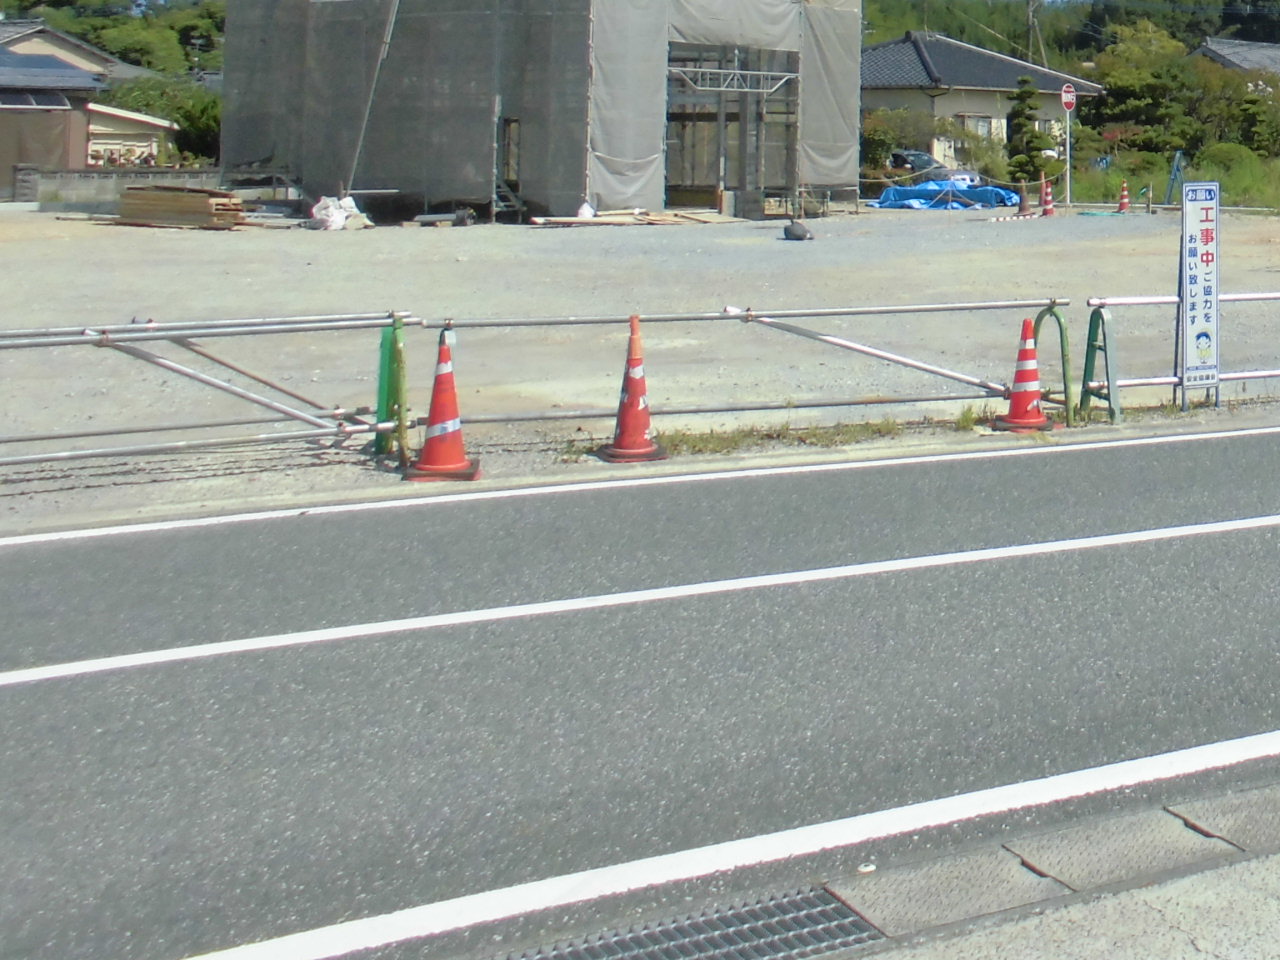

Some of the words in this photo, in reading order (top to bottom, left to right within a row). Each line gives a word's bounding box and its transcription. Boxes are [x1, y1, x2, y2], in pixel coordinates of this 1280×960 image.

[1187, 189, 1215, 201] お願い
[1188, 234, 1199, 326] お願い致します
